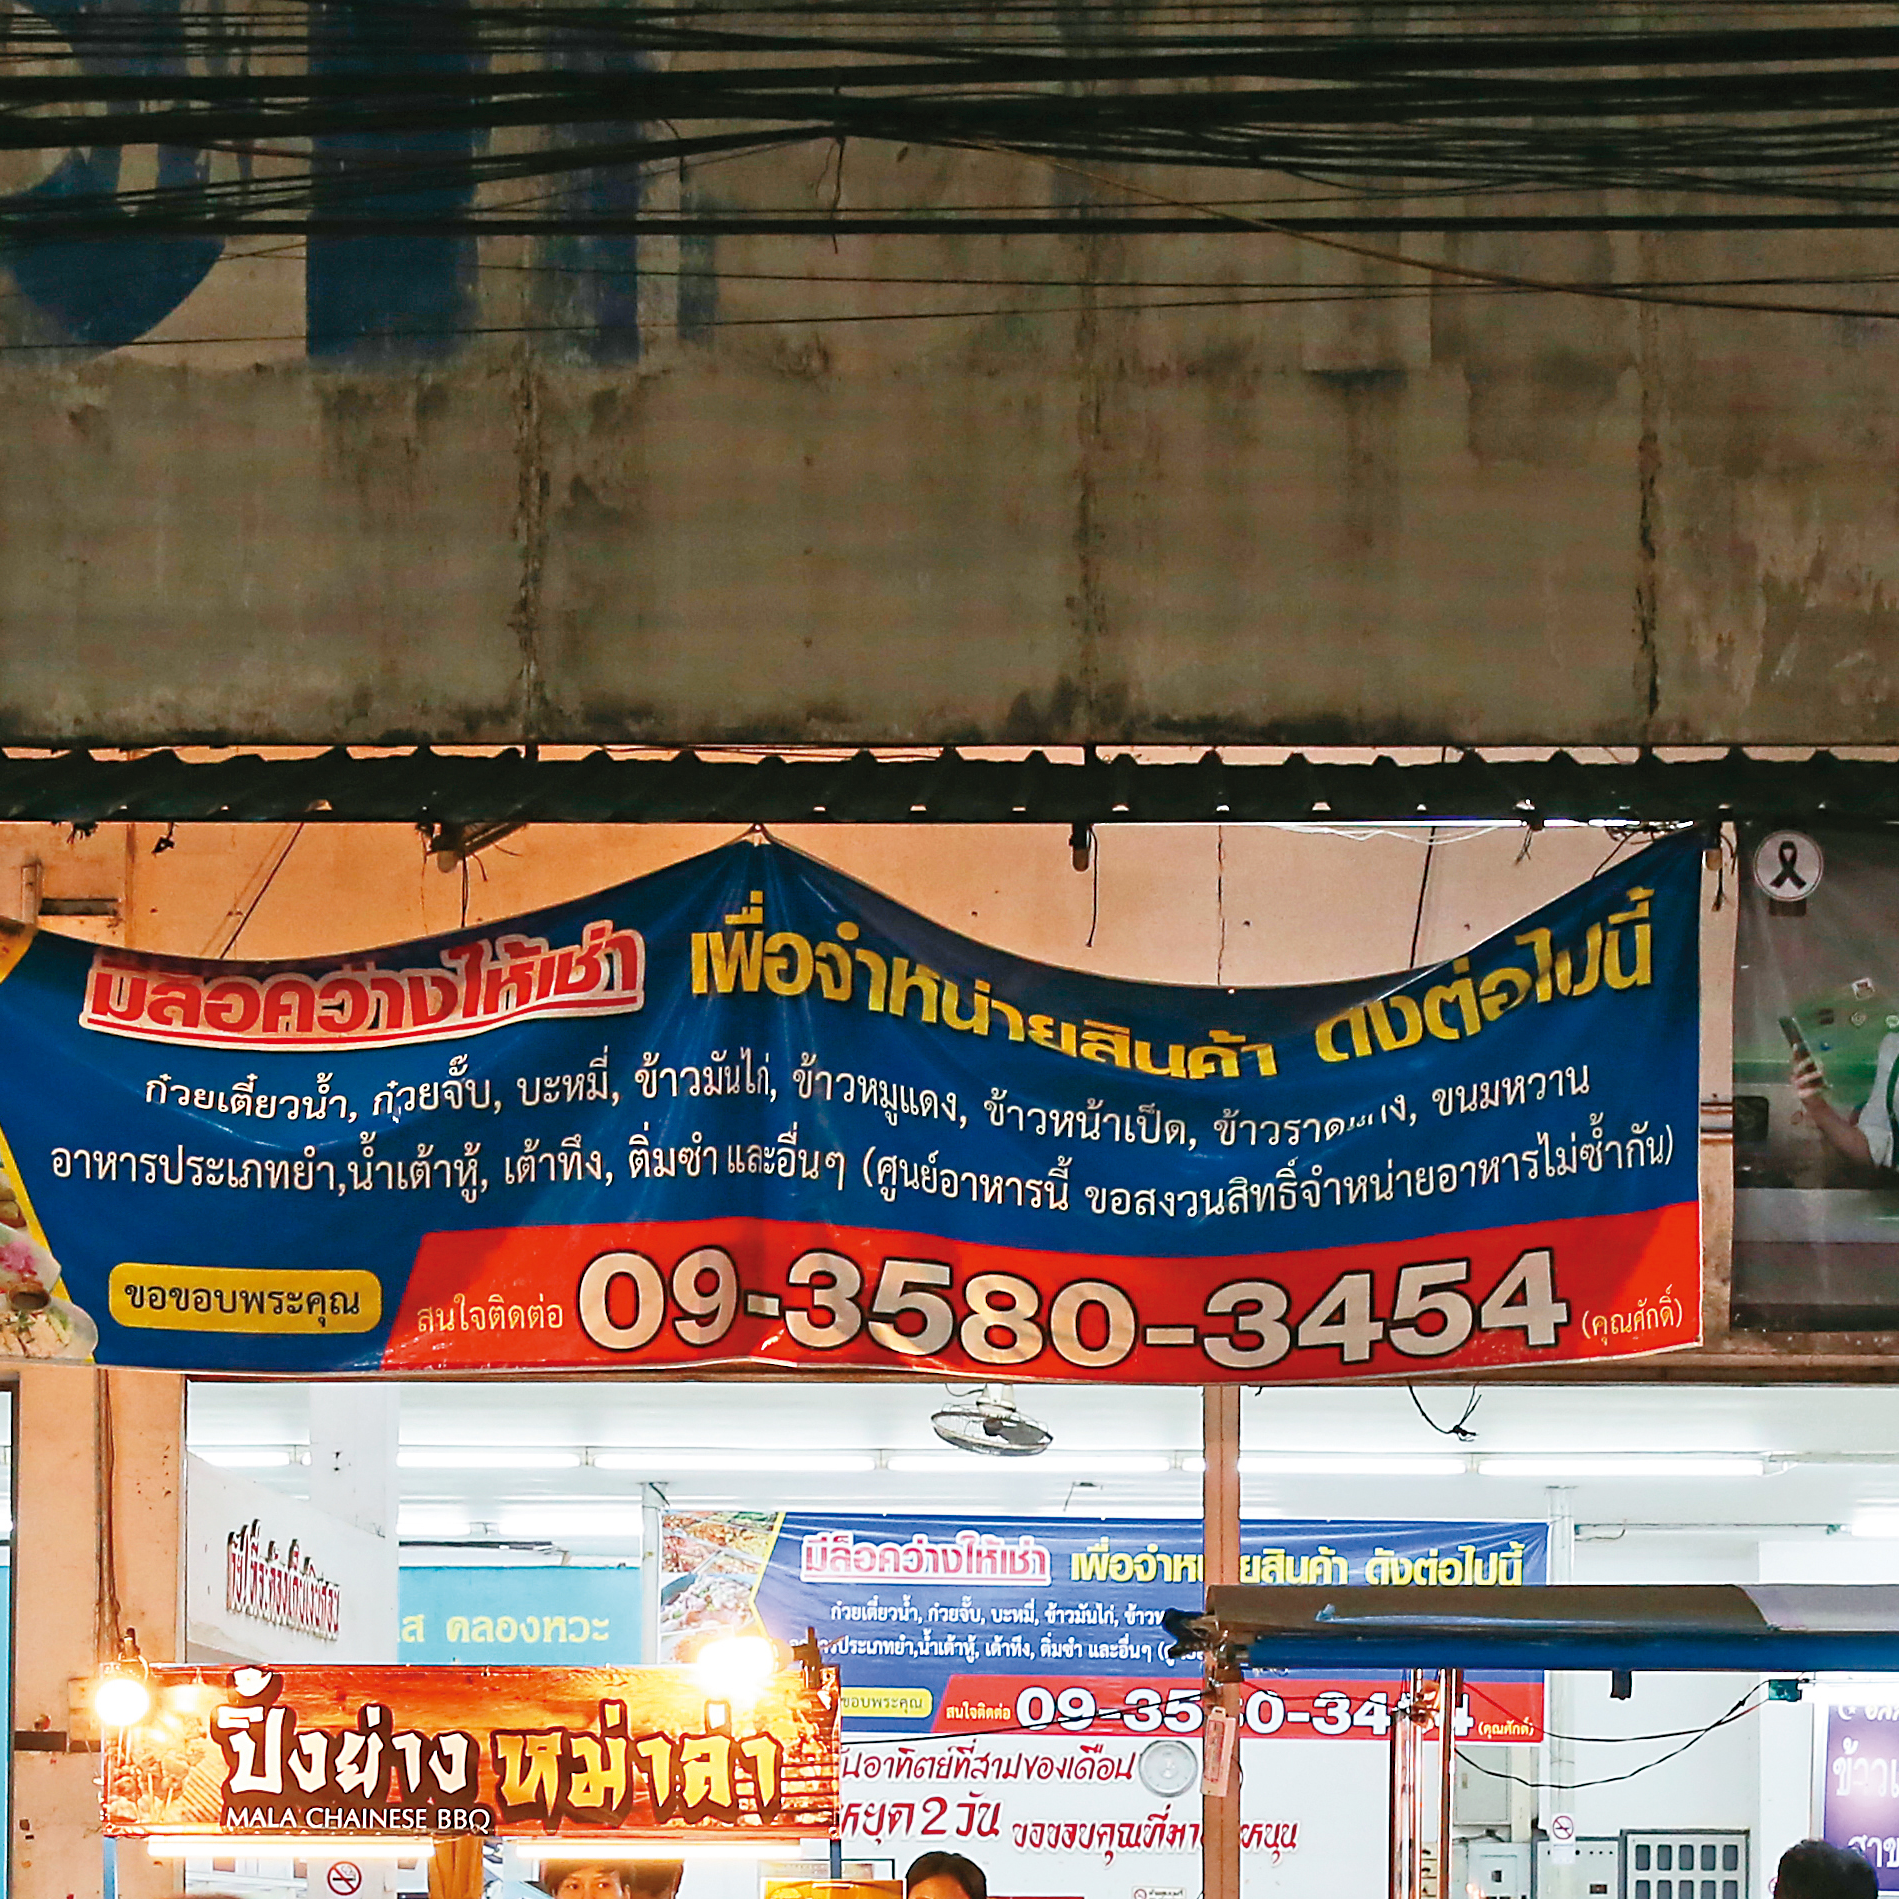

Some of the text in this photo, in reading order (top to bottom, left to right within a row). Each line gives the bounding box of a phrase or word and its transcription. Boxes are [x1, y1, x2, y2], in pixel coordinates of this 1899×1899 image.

[145, 1071, 358, 1123] ก๋วยเตี๋ยวน้ำ,
[517, 1046, 620, 1108] บะหมี่,
[635, 1047, 778, 1101] ข้าวมันไก่,
[792, 1052, 969, 1130] ข้าวหมูแดง,
[983, 1088, 1197, 1151] ข้าวหน้าเป็ด,
[1432, 1064, 1590, 1117] ขนมหวาน
[628, 1122, 718, 1179] ติ่มซำ
[726, 1122, 845, 1189] และอื่นๆ
[862, 1146, 1069, 1214] (ศูนย์อาหารนี้
[123, 1278, 360, 1331] ขอขอบพระคุณ
[417, 1246, 1685, 1370] สนใจติดต่อ 09-3580-3454 (คุณศักดิ์)
[806, 1534, 1523, 1586] มีล็อคว่างให้เช่า ดังต่อไปนี้
[445, 1612, 610, 1645] คลองหวะ
[945, 1701, 1011, 1722] สนใจติดต่อ
[216, 1669, 783, 1822] ปิ้งย่าง หม่าล่า
[226, 1806, 491, 1834] MALA CHAINESE BBQ
[921, 1797, 949, 1835] 2
[956, 1791, 1002, 1837] วัน
